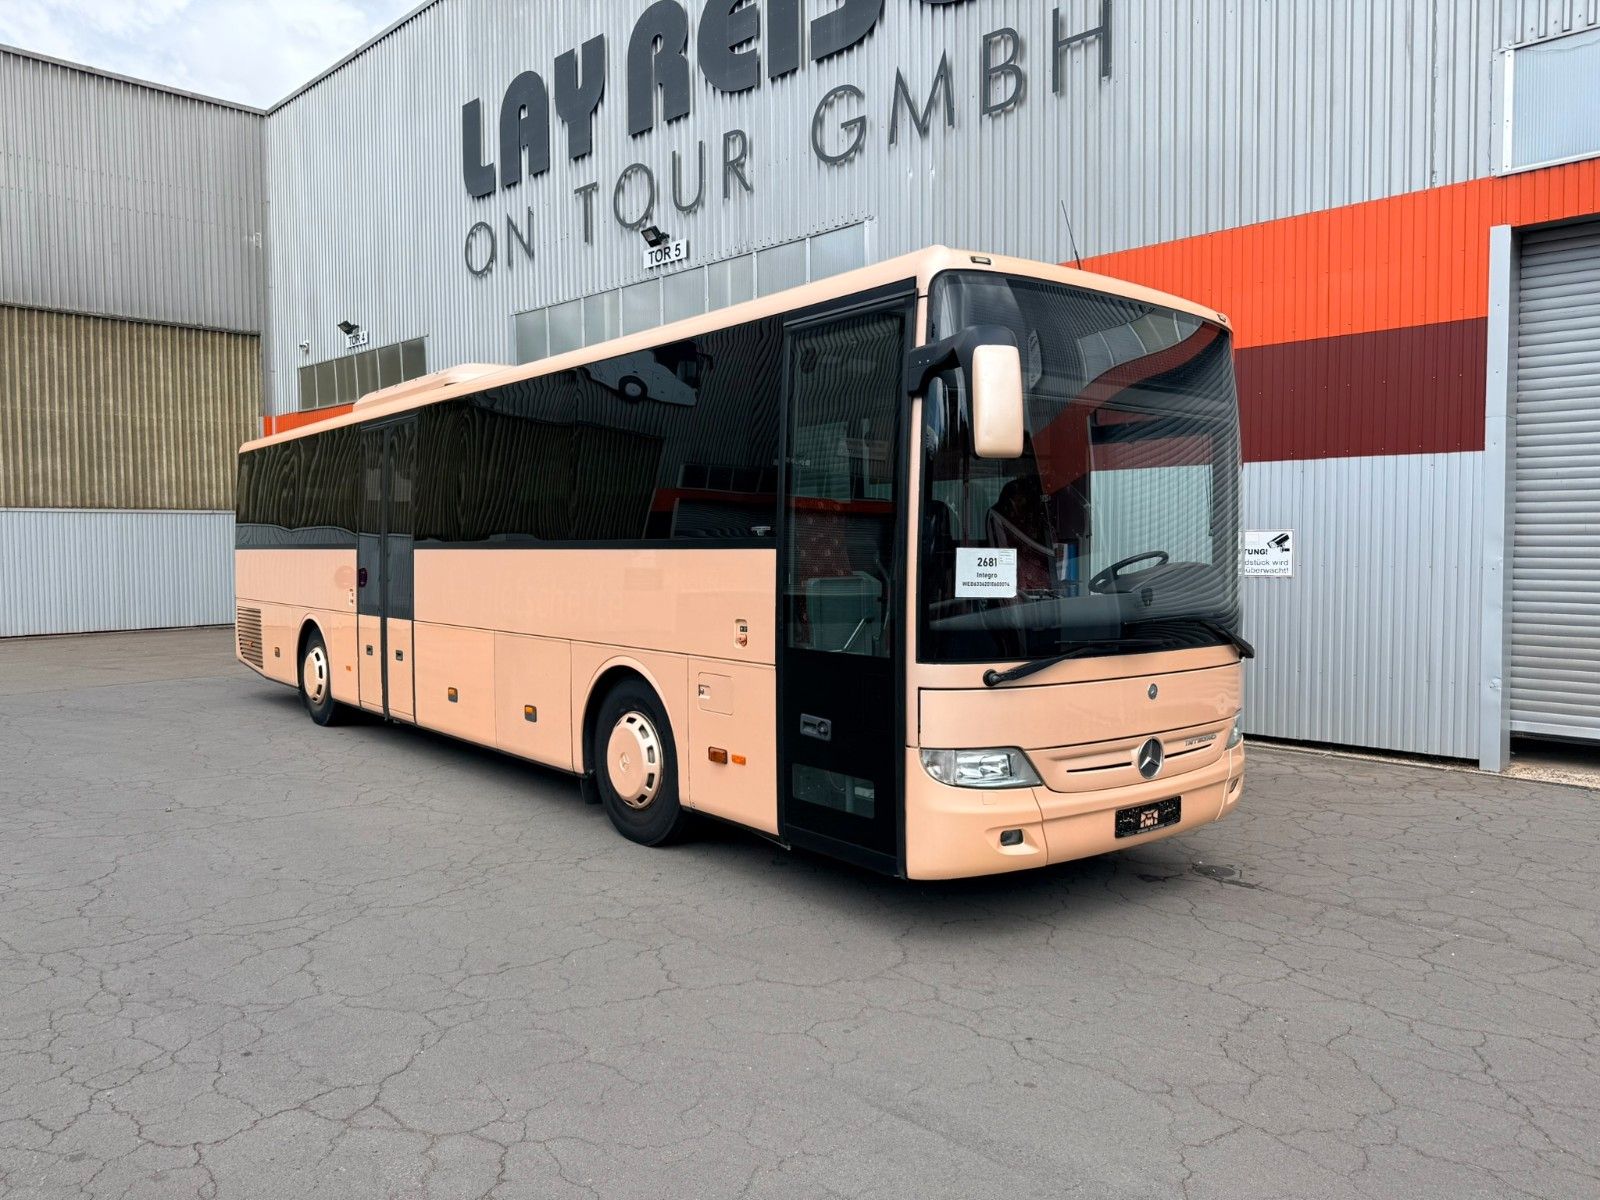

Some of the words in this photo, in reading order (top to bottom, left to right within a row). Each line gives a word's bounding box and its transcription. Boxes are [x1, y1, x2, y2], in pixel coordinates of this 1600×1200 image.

[461, 33, 605, 198] LAY
[627, 0, 983, 136] REI
[464, 206, 535, 276] ON
[574, 129, 751, 244] TOUR
[811, 0, 1112, 165] GMBH
[648, 246, 672, 265] TOR
[675, 243, 681, 257] 5
[348, 334, 360, 345] TOR
[977, 557, 998, 567] 2681
